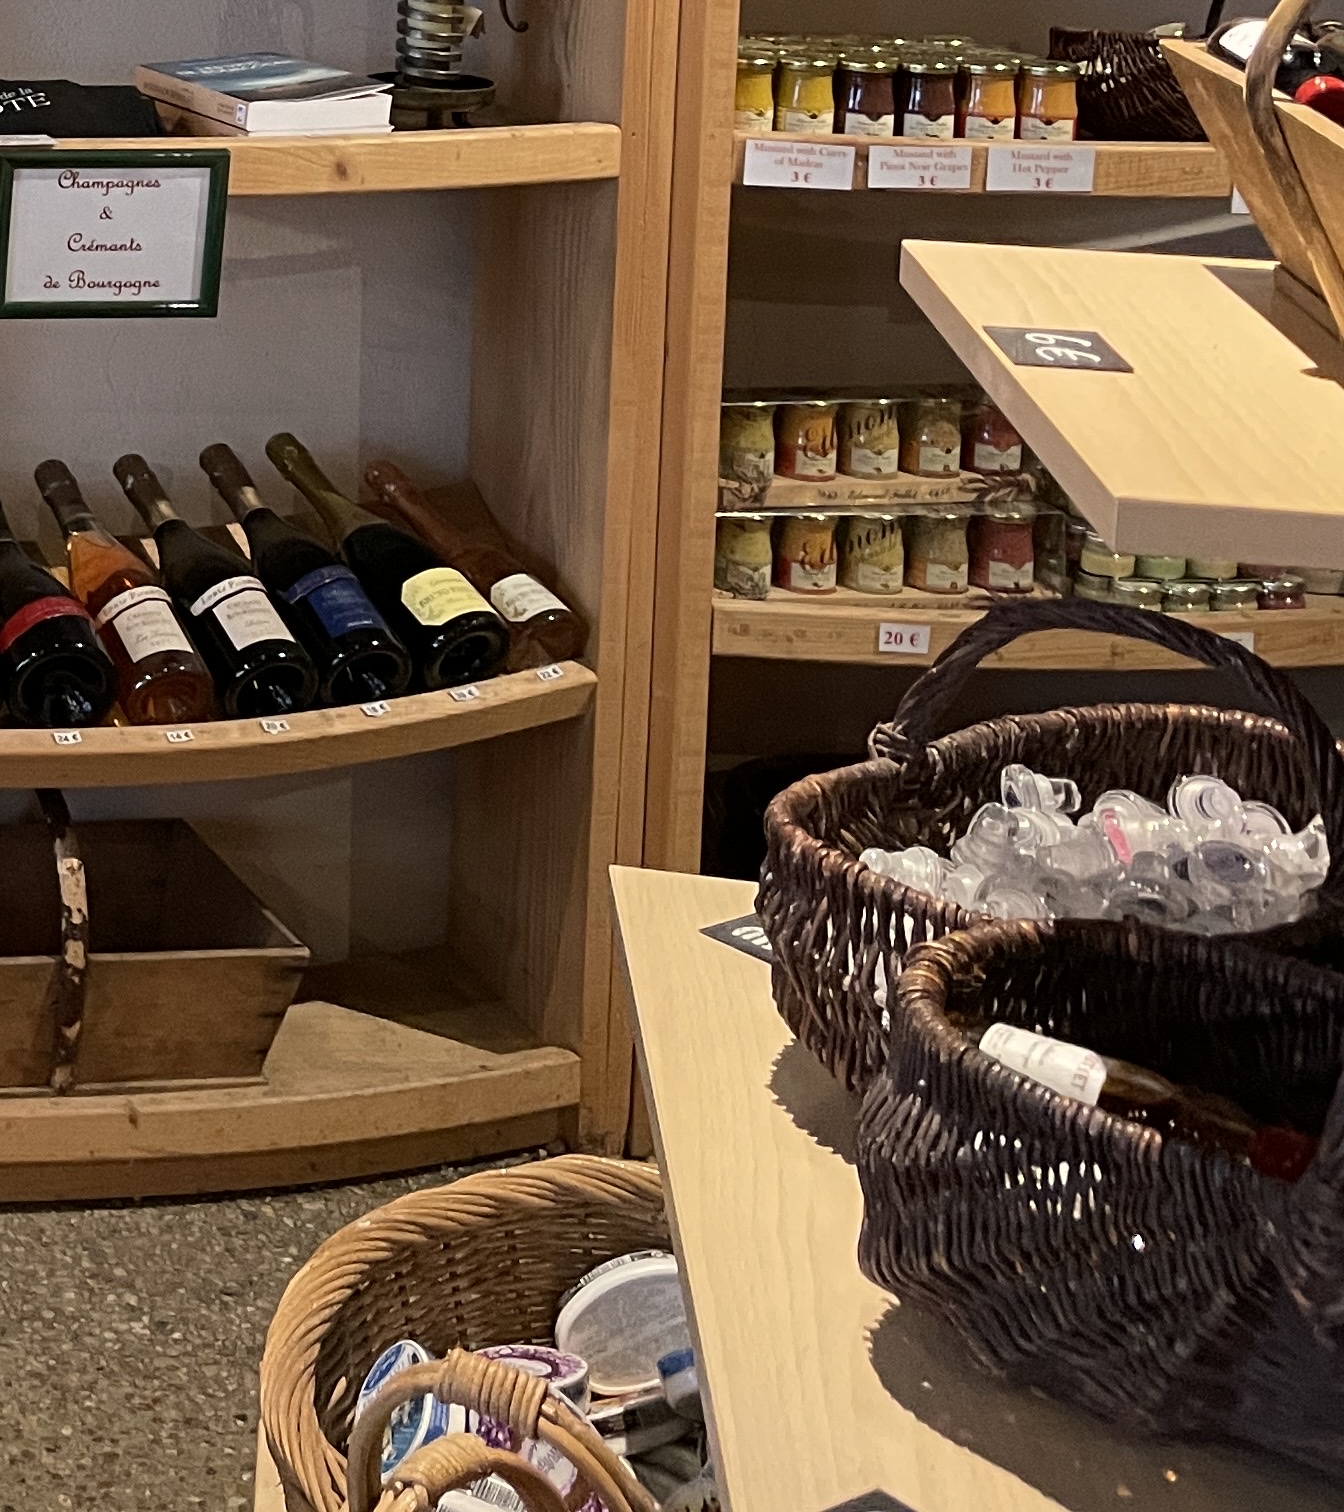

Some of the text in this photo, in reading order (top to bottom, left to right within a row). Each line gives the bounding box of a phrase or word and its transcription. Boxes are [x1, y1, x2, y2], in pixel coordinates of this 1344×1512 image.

[0, 90, 17, 100] de
[19, 87, 33, 95] la
[934, 161, 969, 173] Grapes
[1033, 164, 1069, 176] Pepper
[57, 169, 161, 196] Champagnes
[790, 171, 812, 184] 3 €
[917, 175, 938, 187] 3 €
[1033, 178, 1054, 189] 3 €
[99, 206, 113, 220] &
[67, 232, 143, 252] Crémants
[43, 269, 161, 296] de Bourgogne
[883, 631, 920, 647] 20 €
